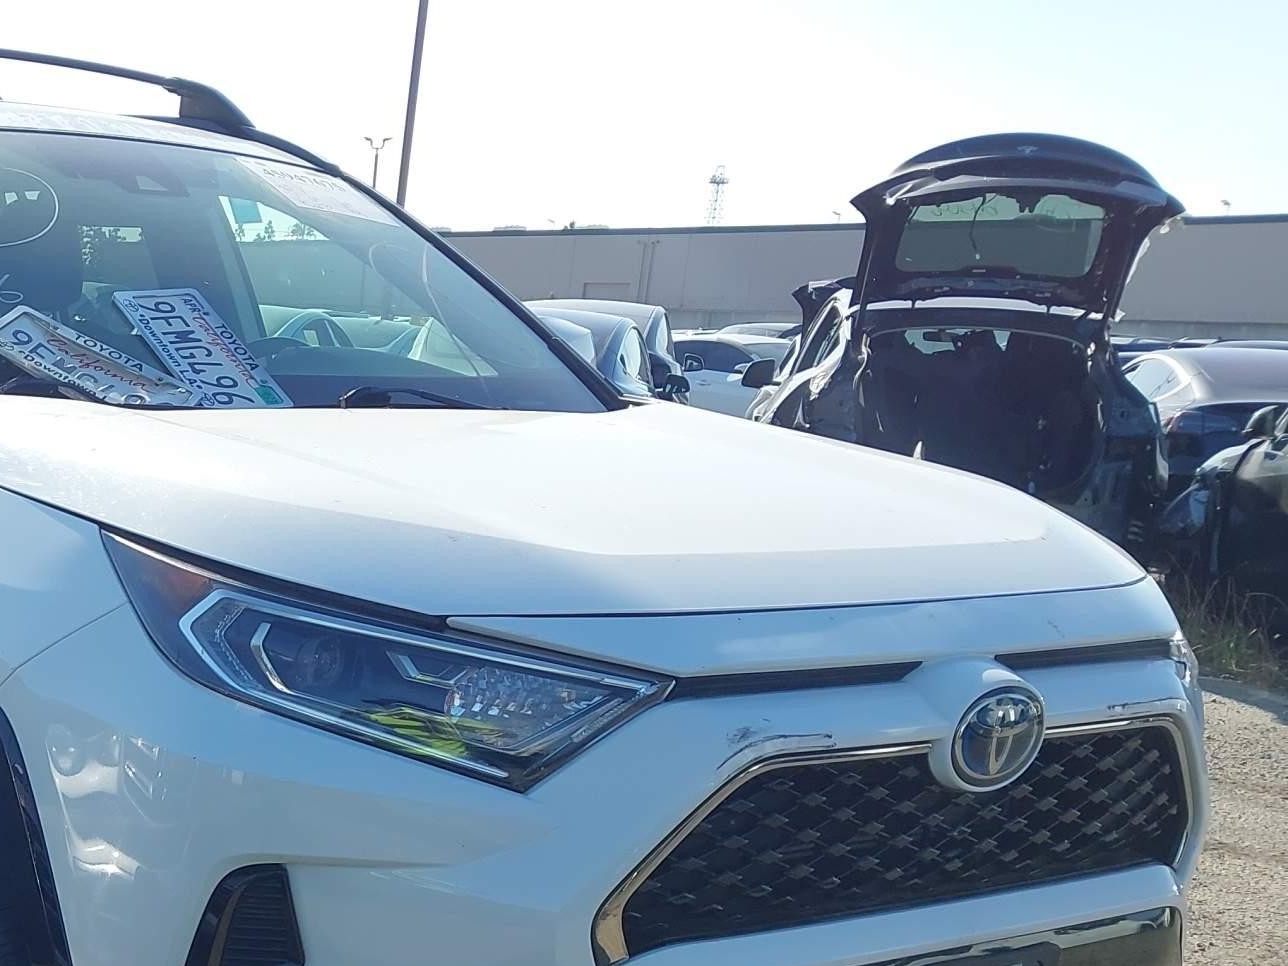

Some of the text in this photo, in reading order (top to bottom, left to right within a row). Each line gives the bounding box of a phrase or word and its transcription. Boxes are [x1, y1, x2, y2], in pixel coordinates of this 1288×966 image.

[47, 337, 155, 393] California
[75, 333, 145, 373] TOYOTA
[137, 301, 255, 405] 9FMG496
[138, 318, 198, 388] Downtown LA
[215, 323, 260, 371] TOYOTA
